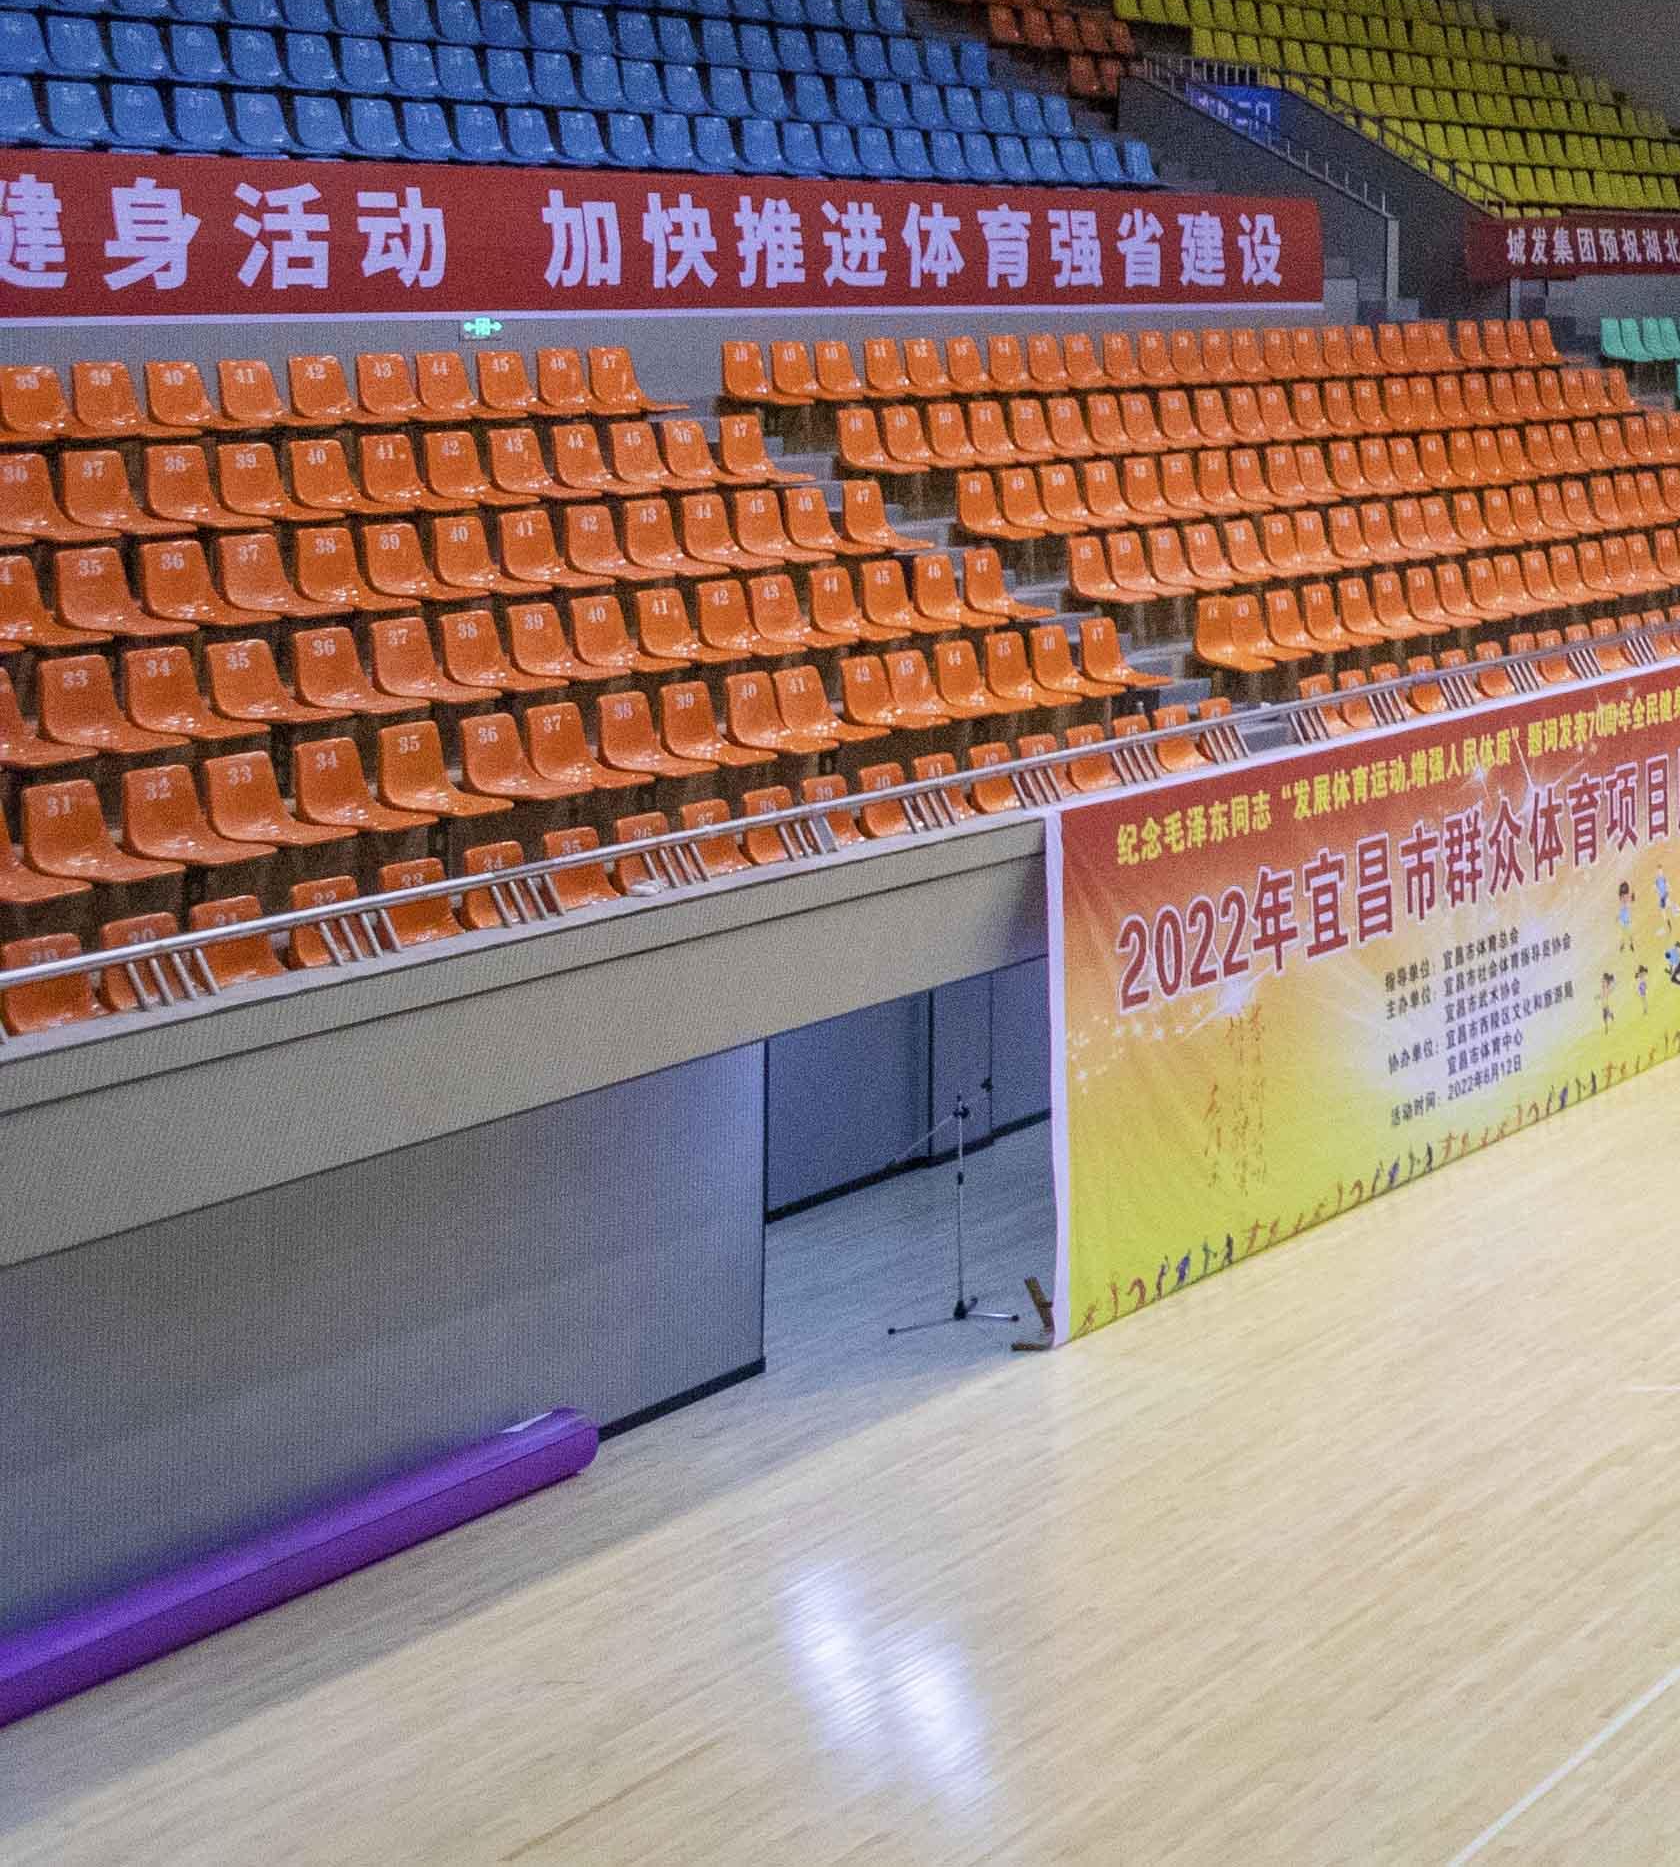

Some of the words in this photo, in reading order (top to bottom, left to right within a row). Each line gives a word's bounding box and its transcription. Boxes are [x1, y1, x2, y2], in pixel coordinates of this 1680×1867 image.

[542, 188, 1283, 290] 加快推进体育强省建设
[1447, 1028, 1524, 1077] 宜昌市体育中心
